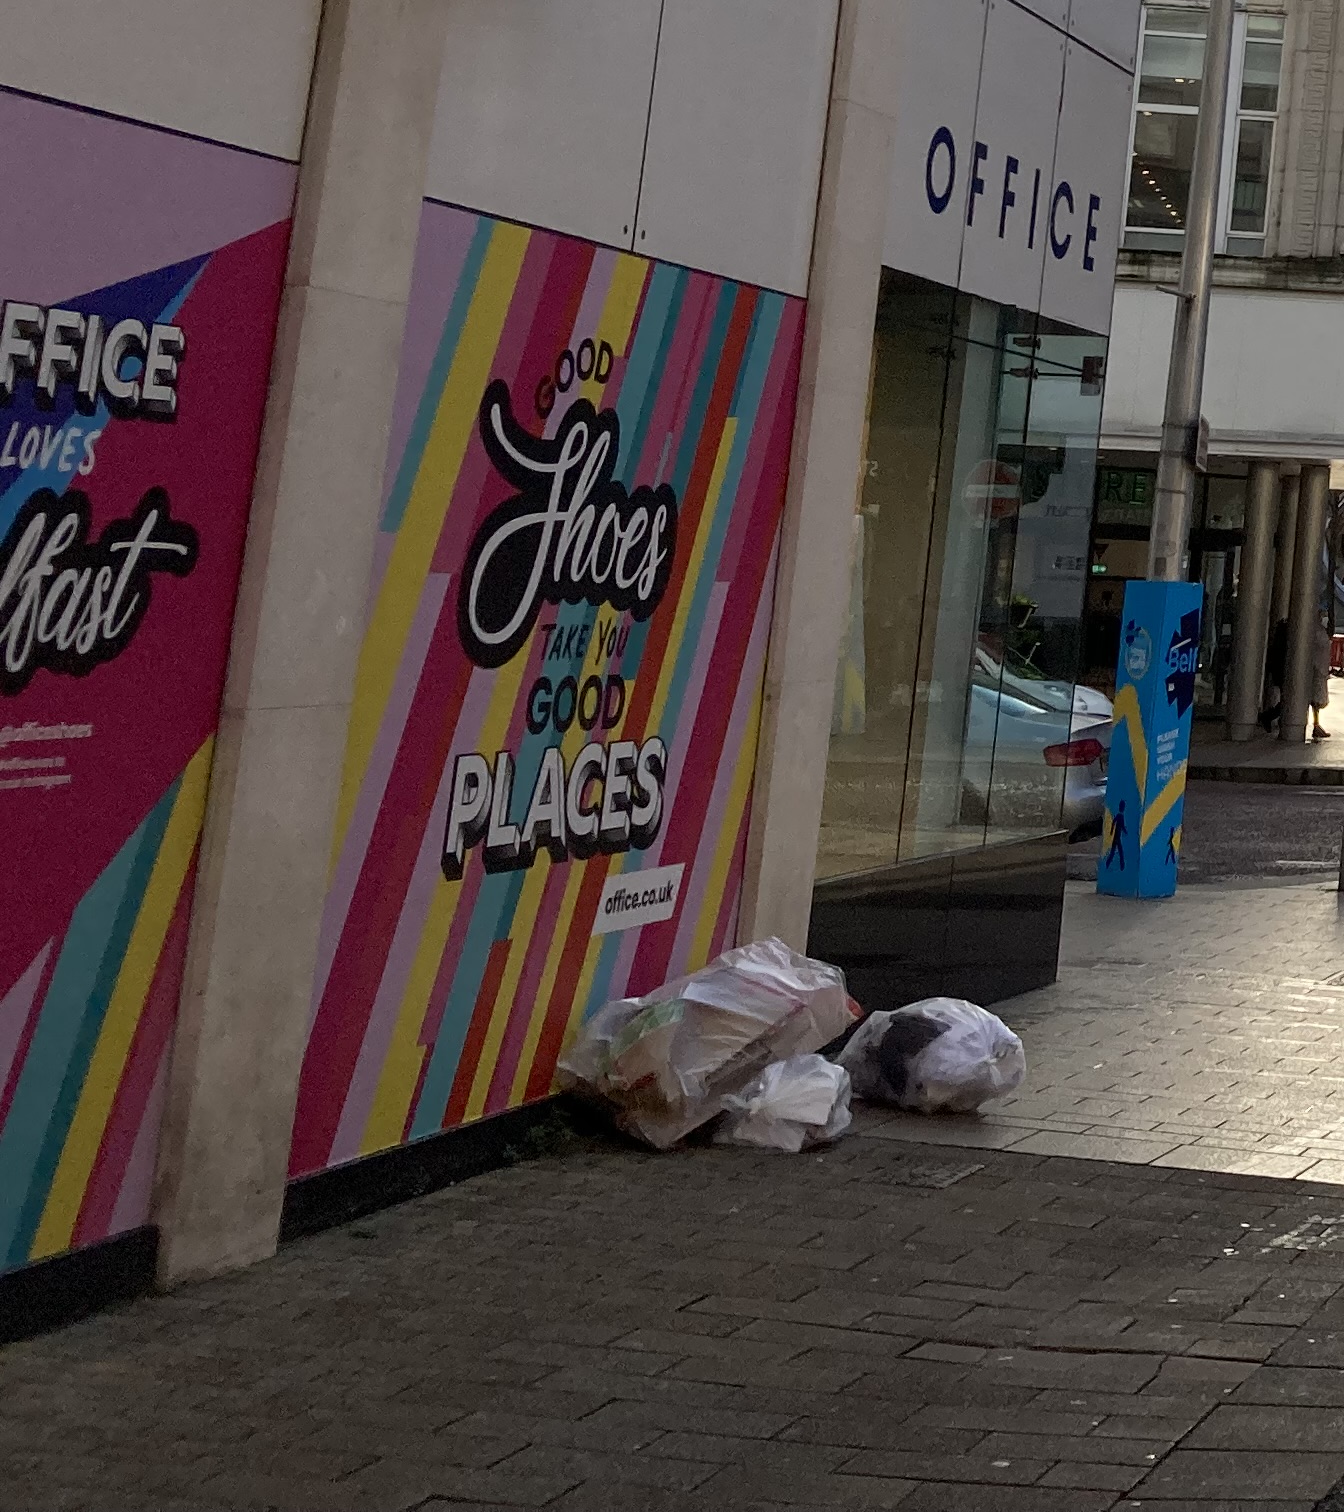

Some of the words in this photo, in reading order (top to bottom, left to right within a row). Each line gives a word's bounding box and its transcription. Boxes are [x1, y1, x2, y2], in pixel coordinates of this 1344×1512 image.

[925, 125, 1101, 271] OFFICE
[533, 337, 614, 419] GOOD
[0, 420, 101, 475] LOVES
[468, 402, 668, 645] Shoes
[541, 622, 589, 662] TAKE
[593, 619, 630, 665] YOU
[526, 674, 626, 736] GOOD
[442, 736, 668, 879] PLACES
[604, 879, 674, 915] office.co.uk
